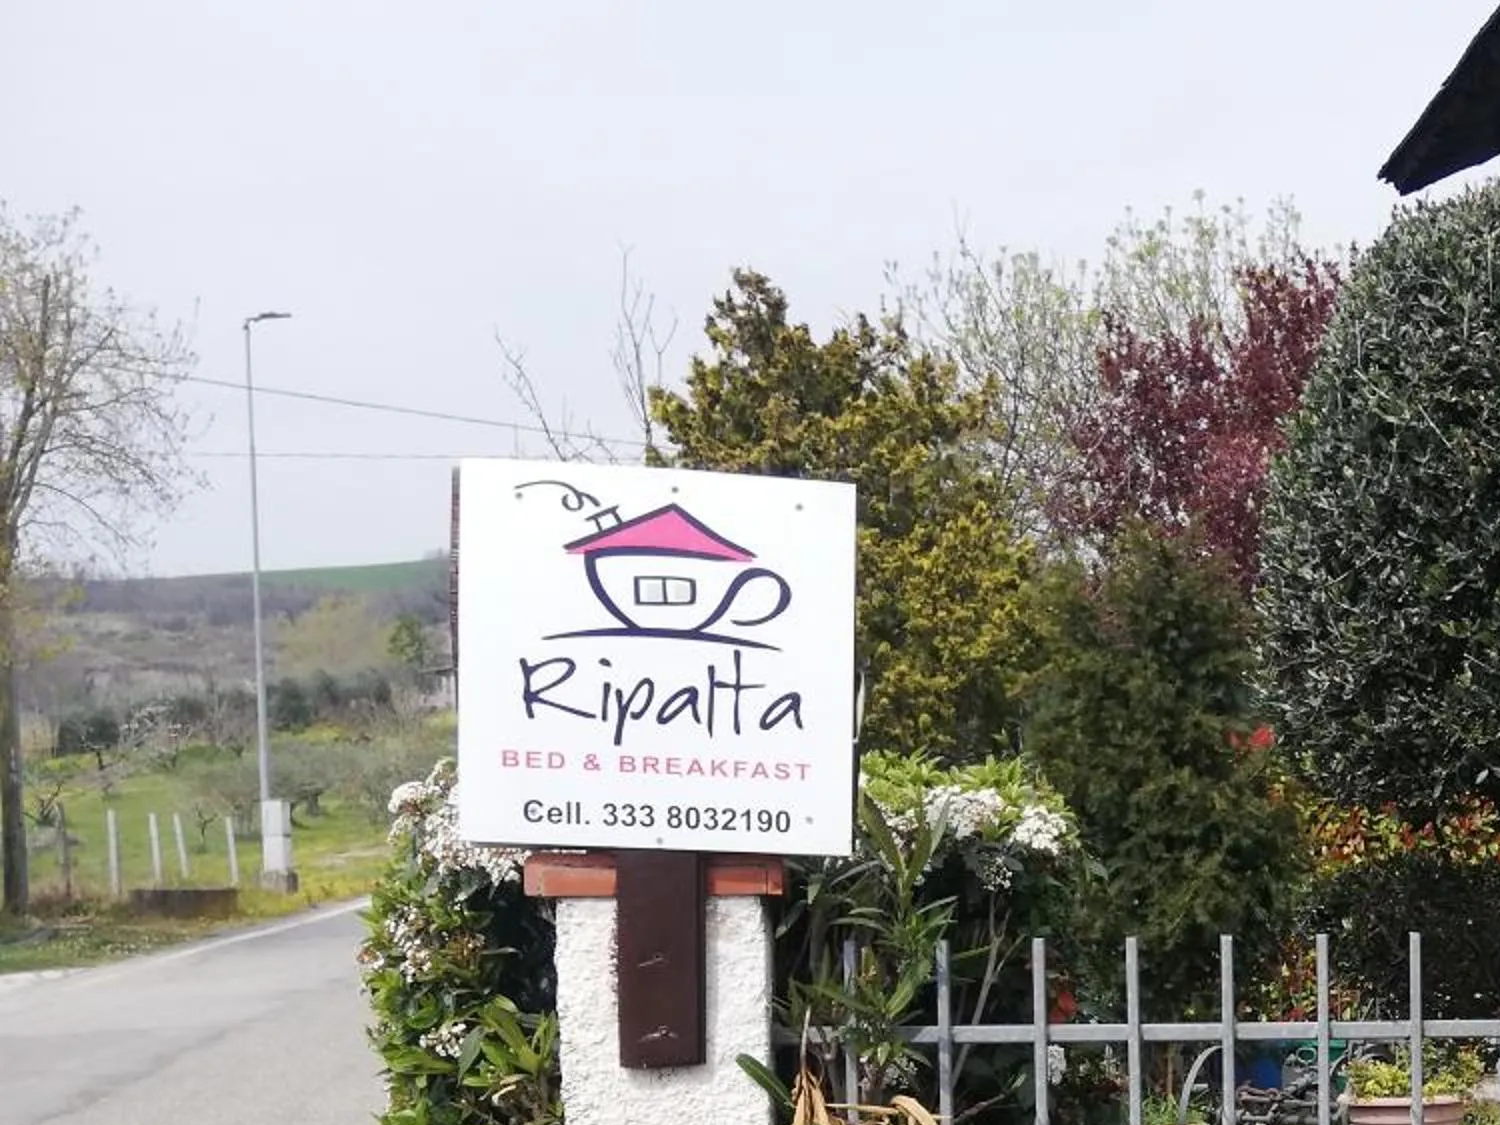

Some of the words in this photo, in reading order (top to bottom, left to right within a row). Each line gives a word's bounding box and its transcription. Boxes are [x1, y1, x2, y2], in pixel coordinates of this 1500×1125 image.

[501, 750, 565, 770] BED
[583, 753, 601, 771] &
[619, 755, 812, 781] BREAKFAST
[523, 800, 591, 826] Cell.
[602, 804, 655, 828] 333
[666, 805, 791, 833] 8032190
